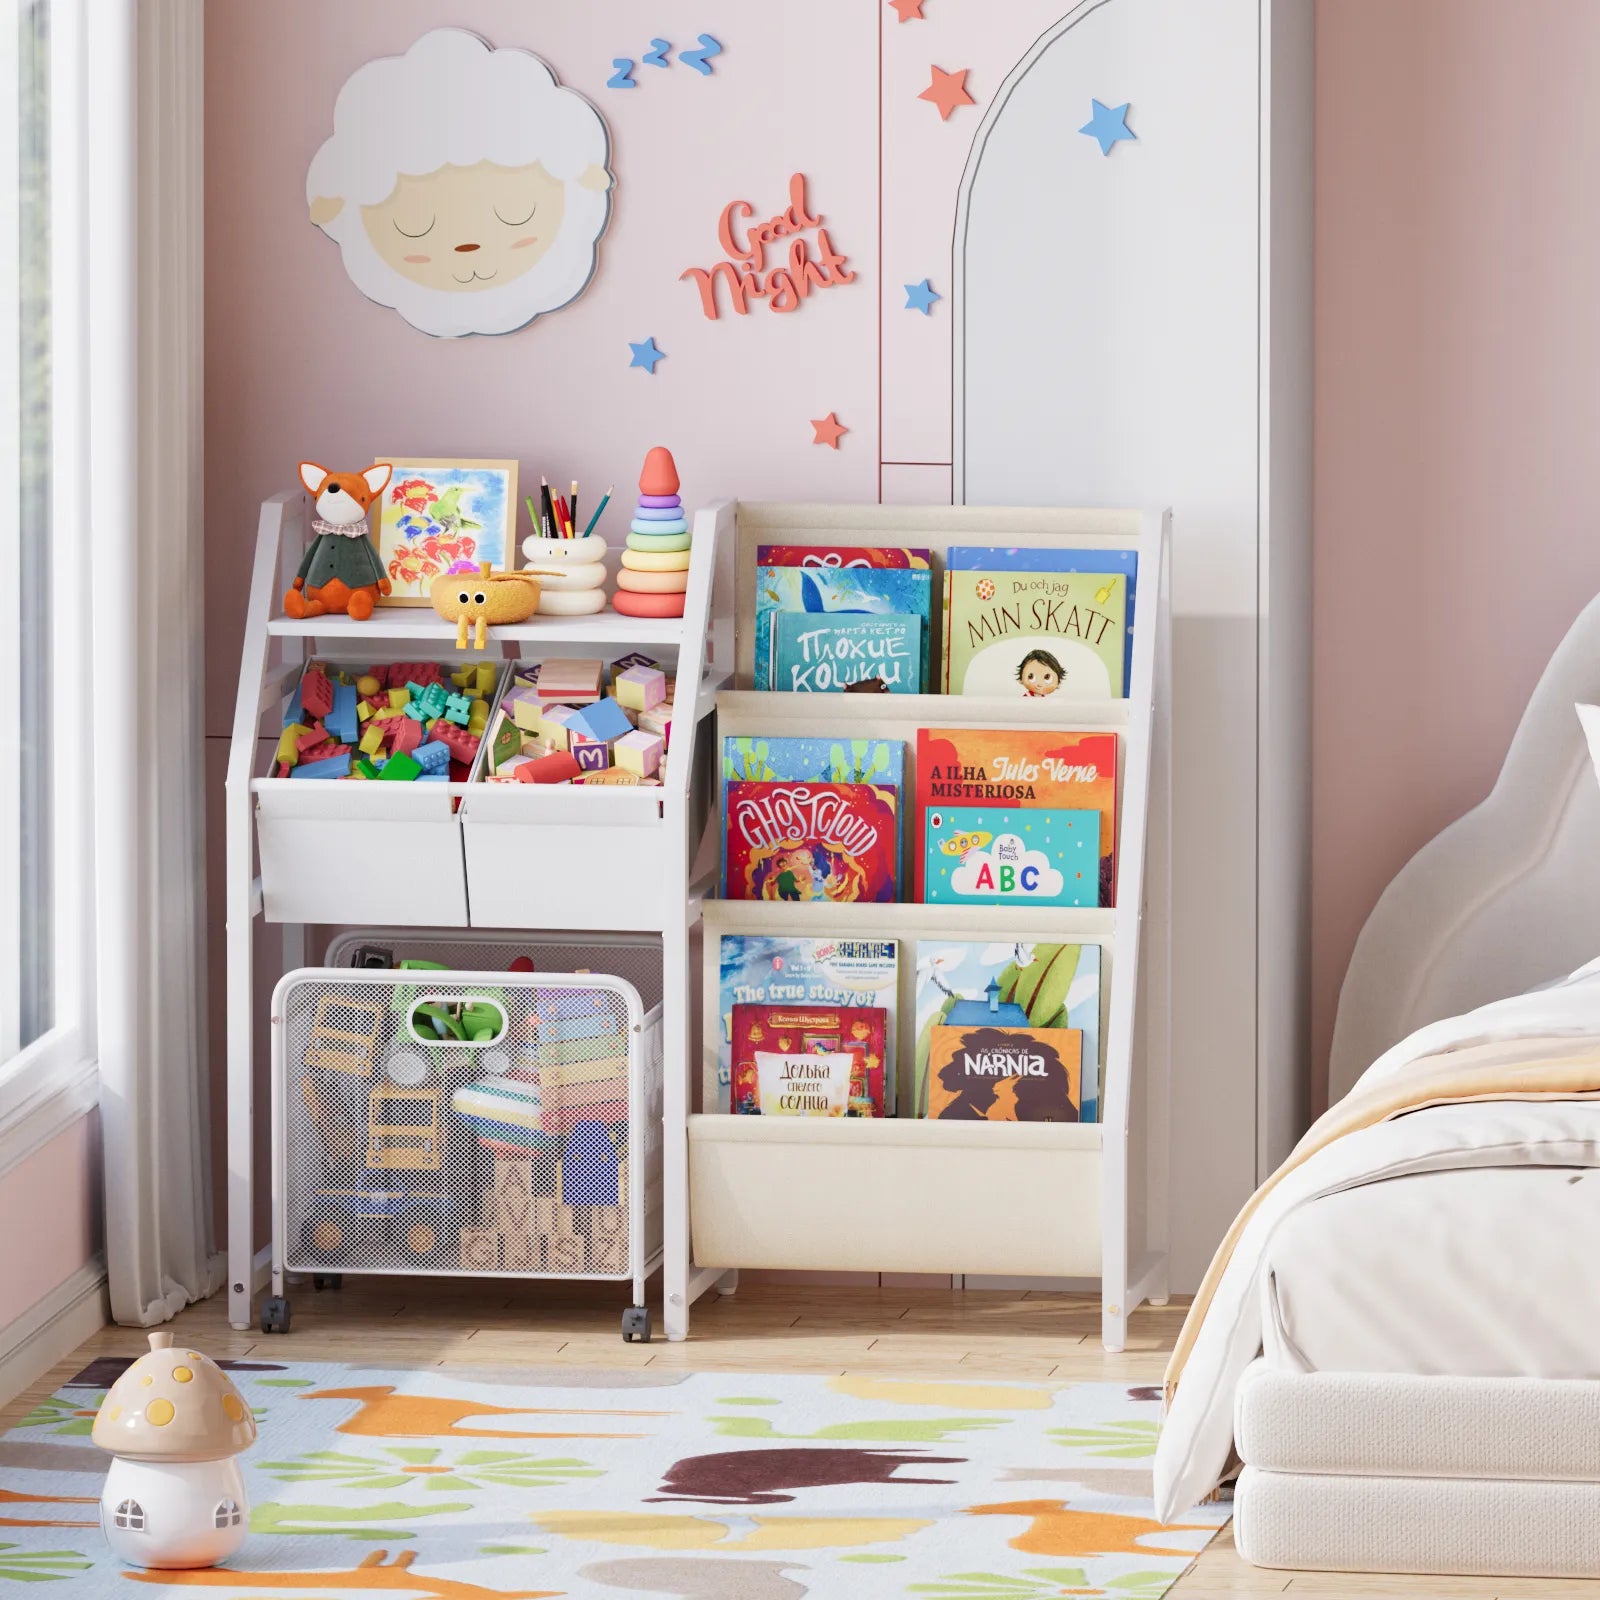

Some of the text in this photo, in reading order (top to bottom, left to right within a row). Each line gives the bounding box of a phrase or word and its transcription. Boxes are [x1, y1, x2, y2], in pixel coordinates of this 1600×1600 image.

[718, 172, 825, 273] Good
[679, 229, 856, 320] Night
[1013, 579, 1069, 598] Du och jag
[968, 598, 1116, 648] MIN SKATT
[579, 748, 604, 769] M
[930, 766, 987, 781] A ILHA
[991, 757, 1098, 783] Jules Verne
[930, 783, 1036, 800] MISTERIOSA
[734, 984, 876, 1006] The true story of
